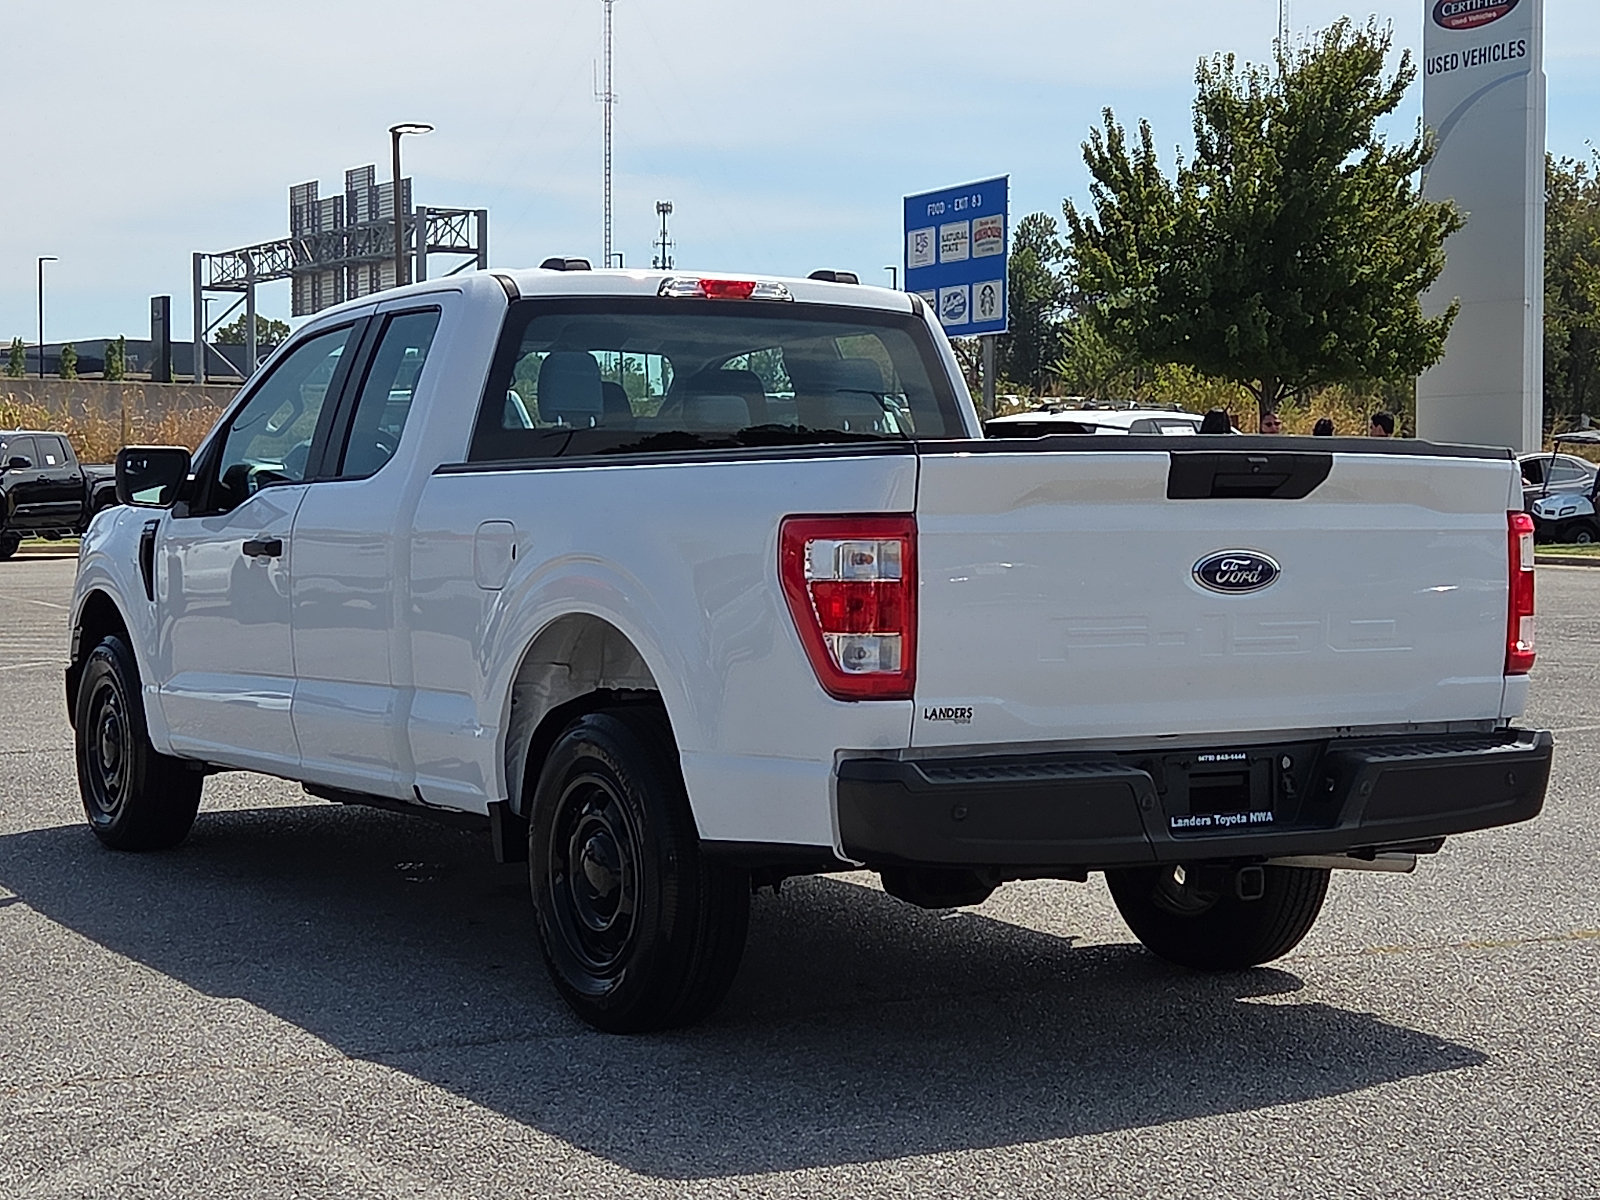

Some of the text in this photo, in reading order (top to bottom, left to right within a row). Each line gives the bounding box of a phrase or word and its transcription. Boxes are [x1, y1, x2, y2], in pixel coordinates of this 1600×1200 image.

[1427, 40, 1526, 75] USED VEHICLES
[927, 202, 945, 216] FOOD
[954, 197, 969, 211] EXIT
[1216, 559, 1263, 583] Ford
[1038, 612, 1414, 662] F-150
[924, 707, 973, 720] LANDERS
[1171, 811, 1273, 828] Landers Toyota NWA
